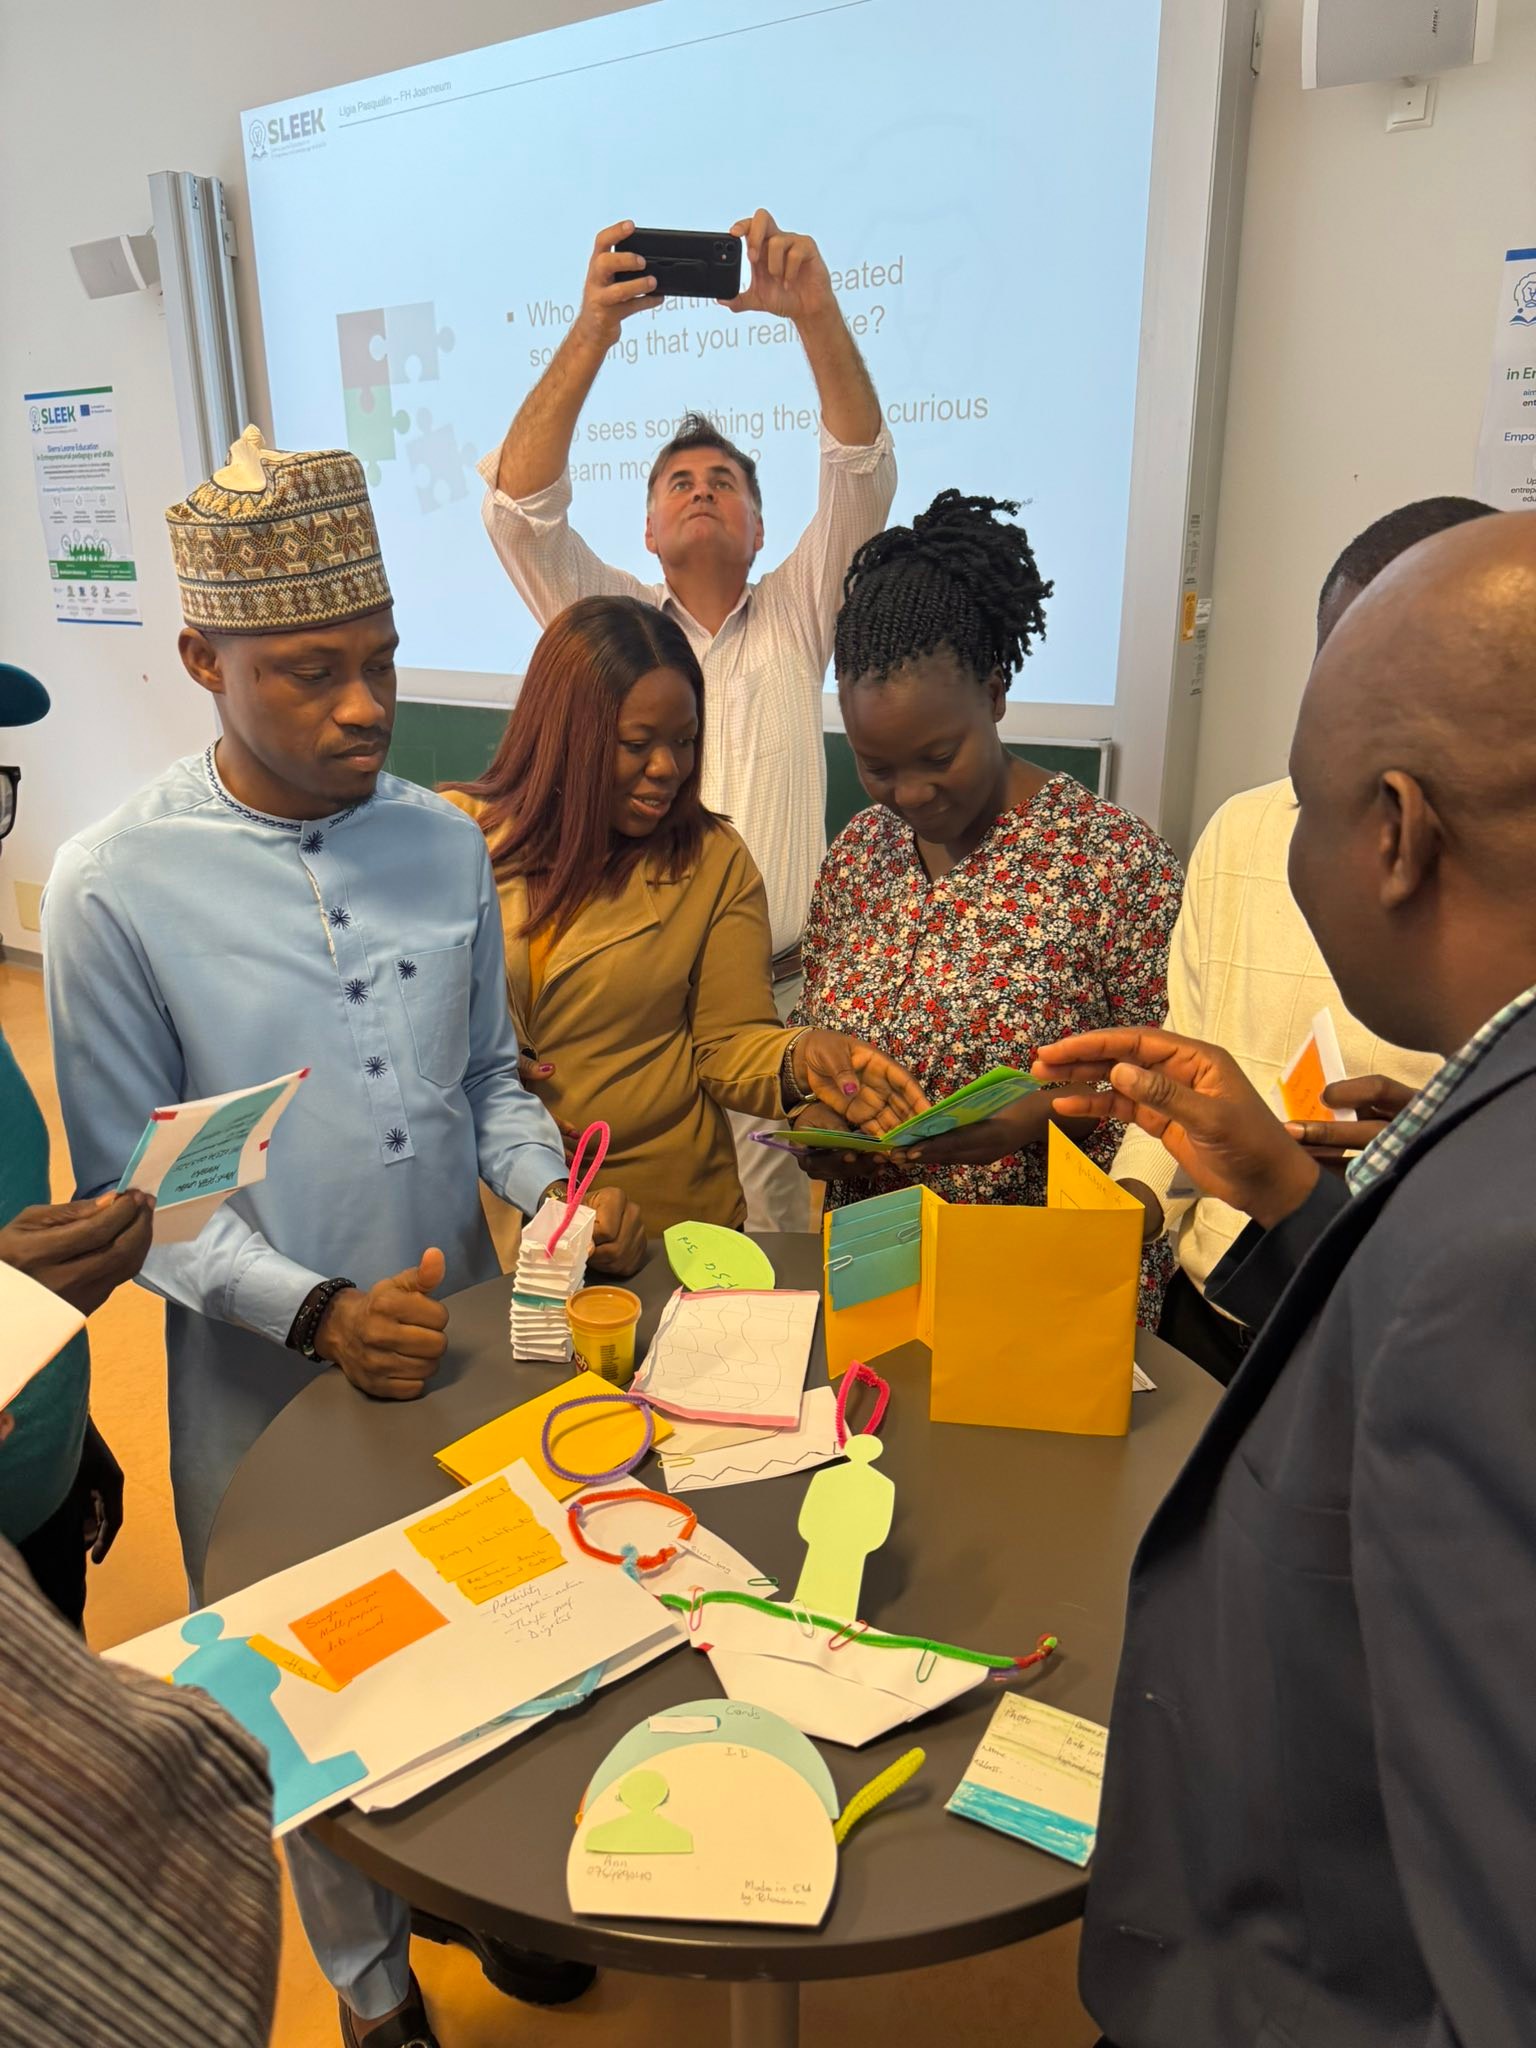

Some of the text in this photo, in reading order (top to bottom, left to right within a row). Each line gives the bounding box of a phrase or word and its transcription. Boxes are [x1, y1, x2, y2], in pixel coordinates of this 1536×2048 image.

[400, 89, 412, 101] FH
[268, 107, 326, 145] SLEEK
[831, 256, 903, 291] eated
[527, 301, 575, 327] Who
[647, 328, 689, 356] that
[697, 327, 738, 358] you
[1506, 367, 1520, 380] in
[41, 406, 76, 425] SLEEK
[587, 421, 637, 442] sees
[887, 393, 989, 424] curious
[1504, 432, 1536, 444] Empo
[569, 462, 612, 481] earn
